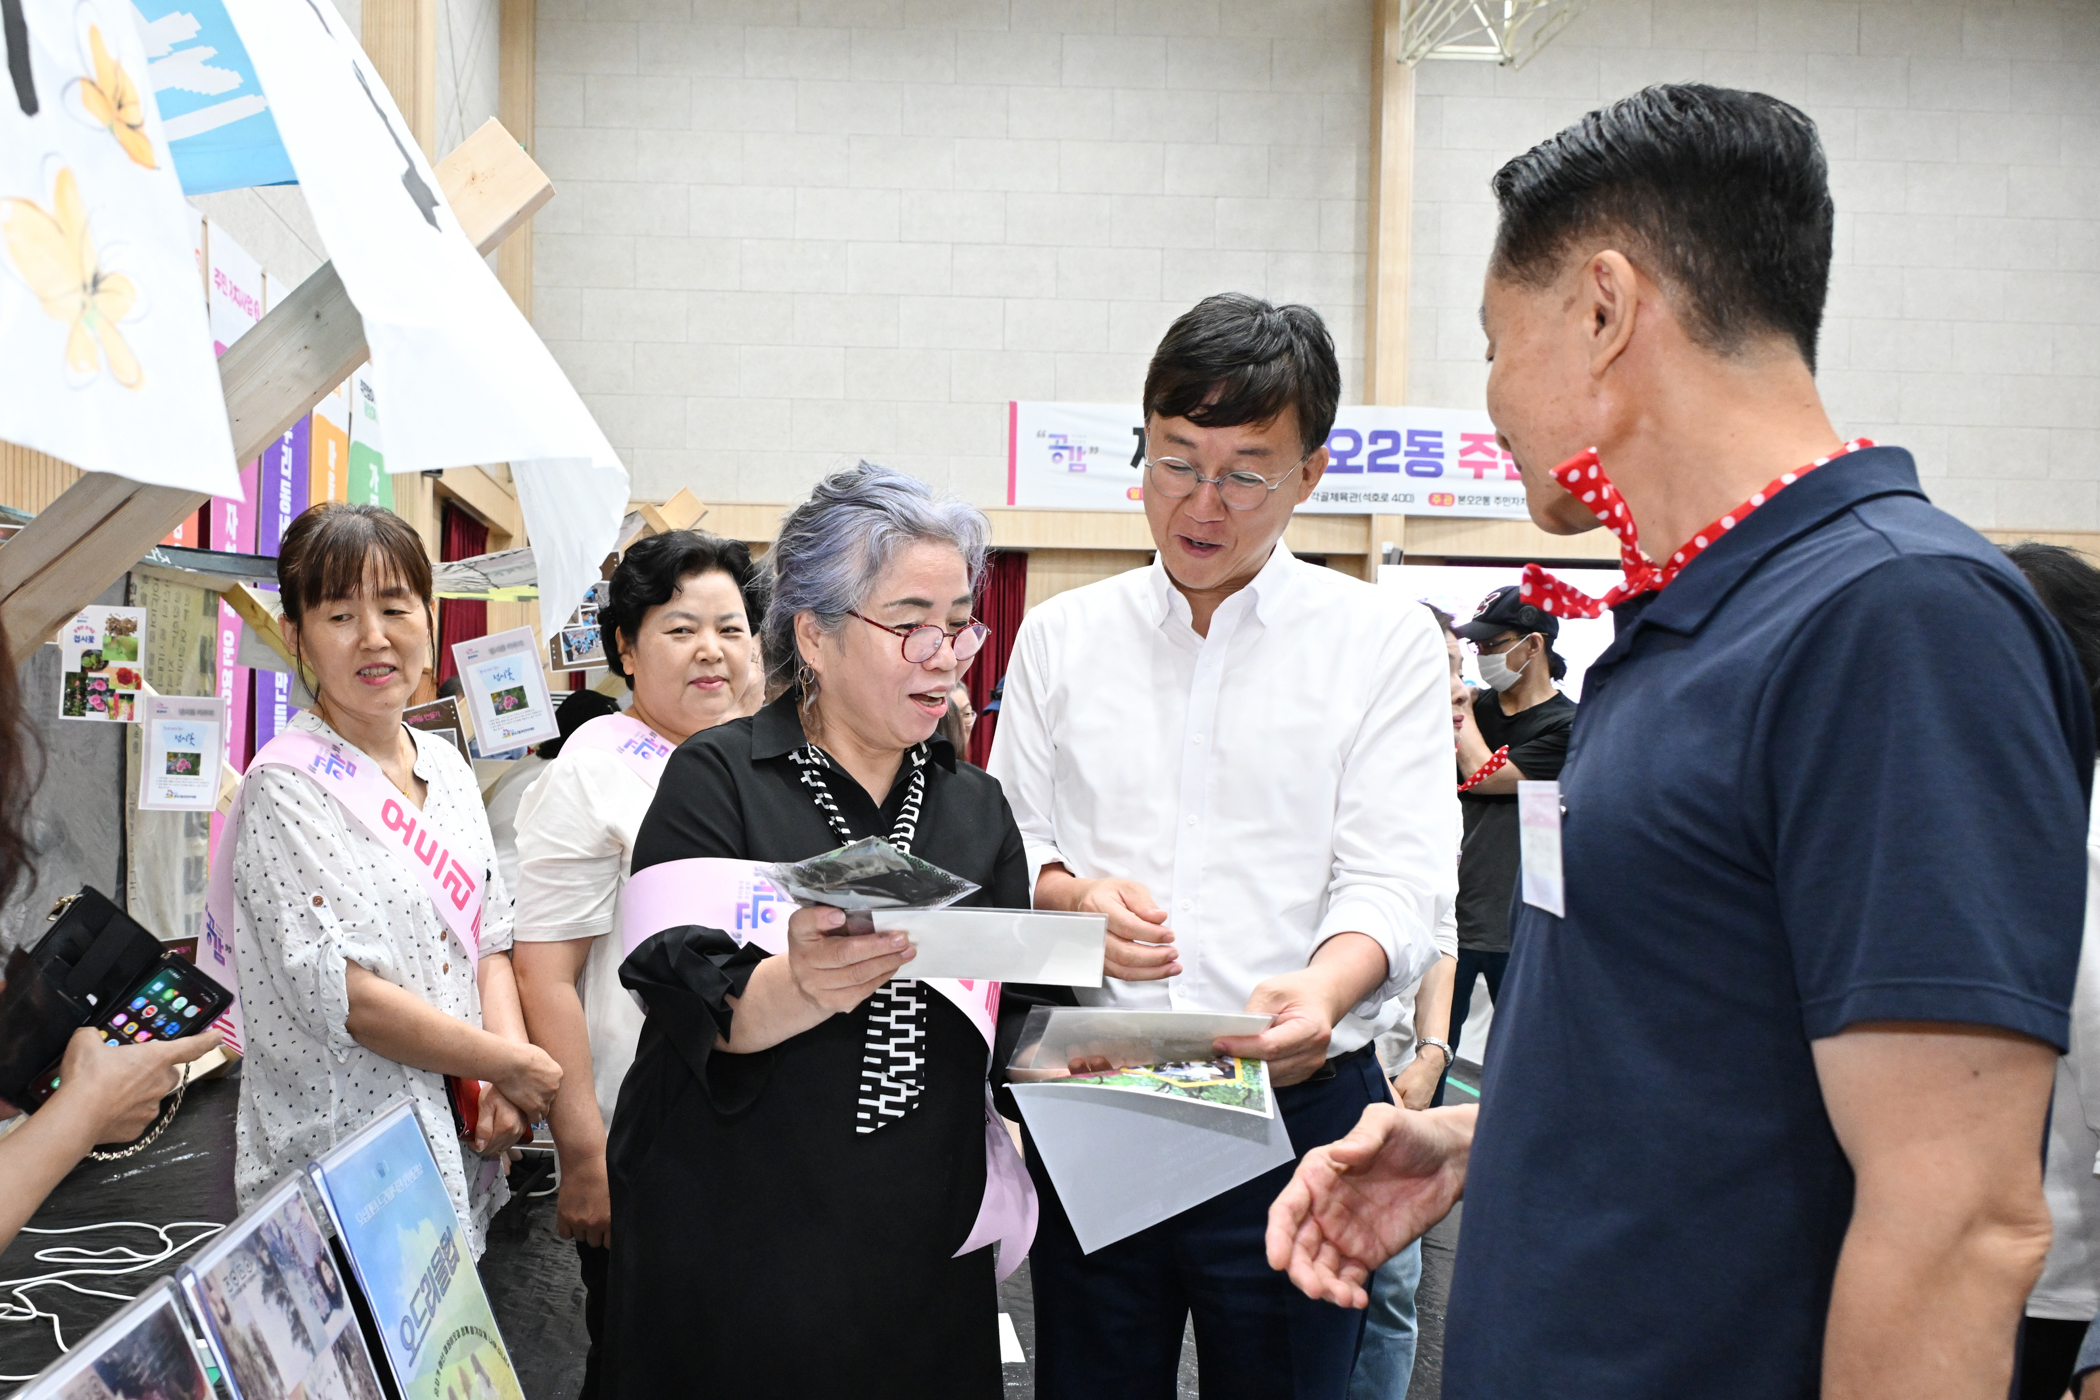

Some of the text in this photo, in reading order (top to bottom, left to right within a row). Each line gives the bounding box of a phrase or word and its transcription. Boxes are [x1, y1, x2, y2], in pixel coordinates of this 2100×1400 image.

[1431, 493, 1454, 506] 주관
[1458, 495, 1491, 506] 본오2동
[74, 634, 95, 644] 접시꽃
